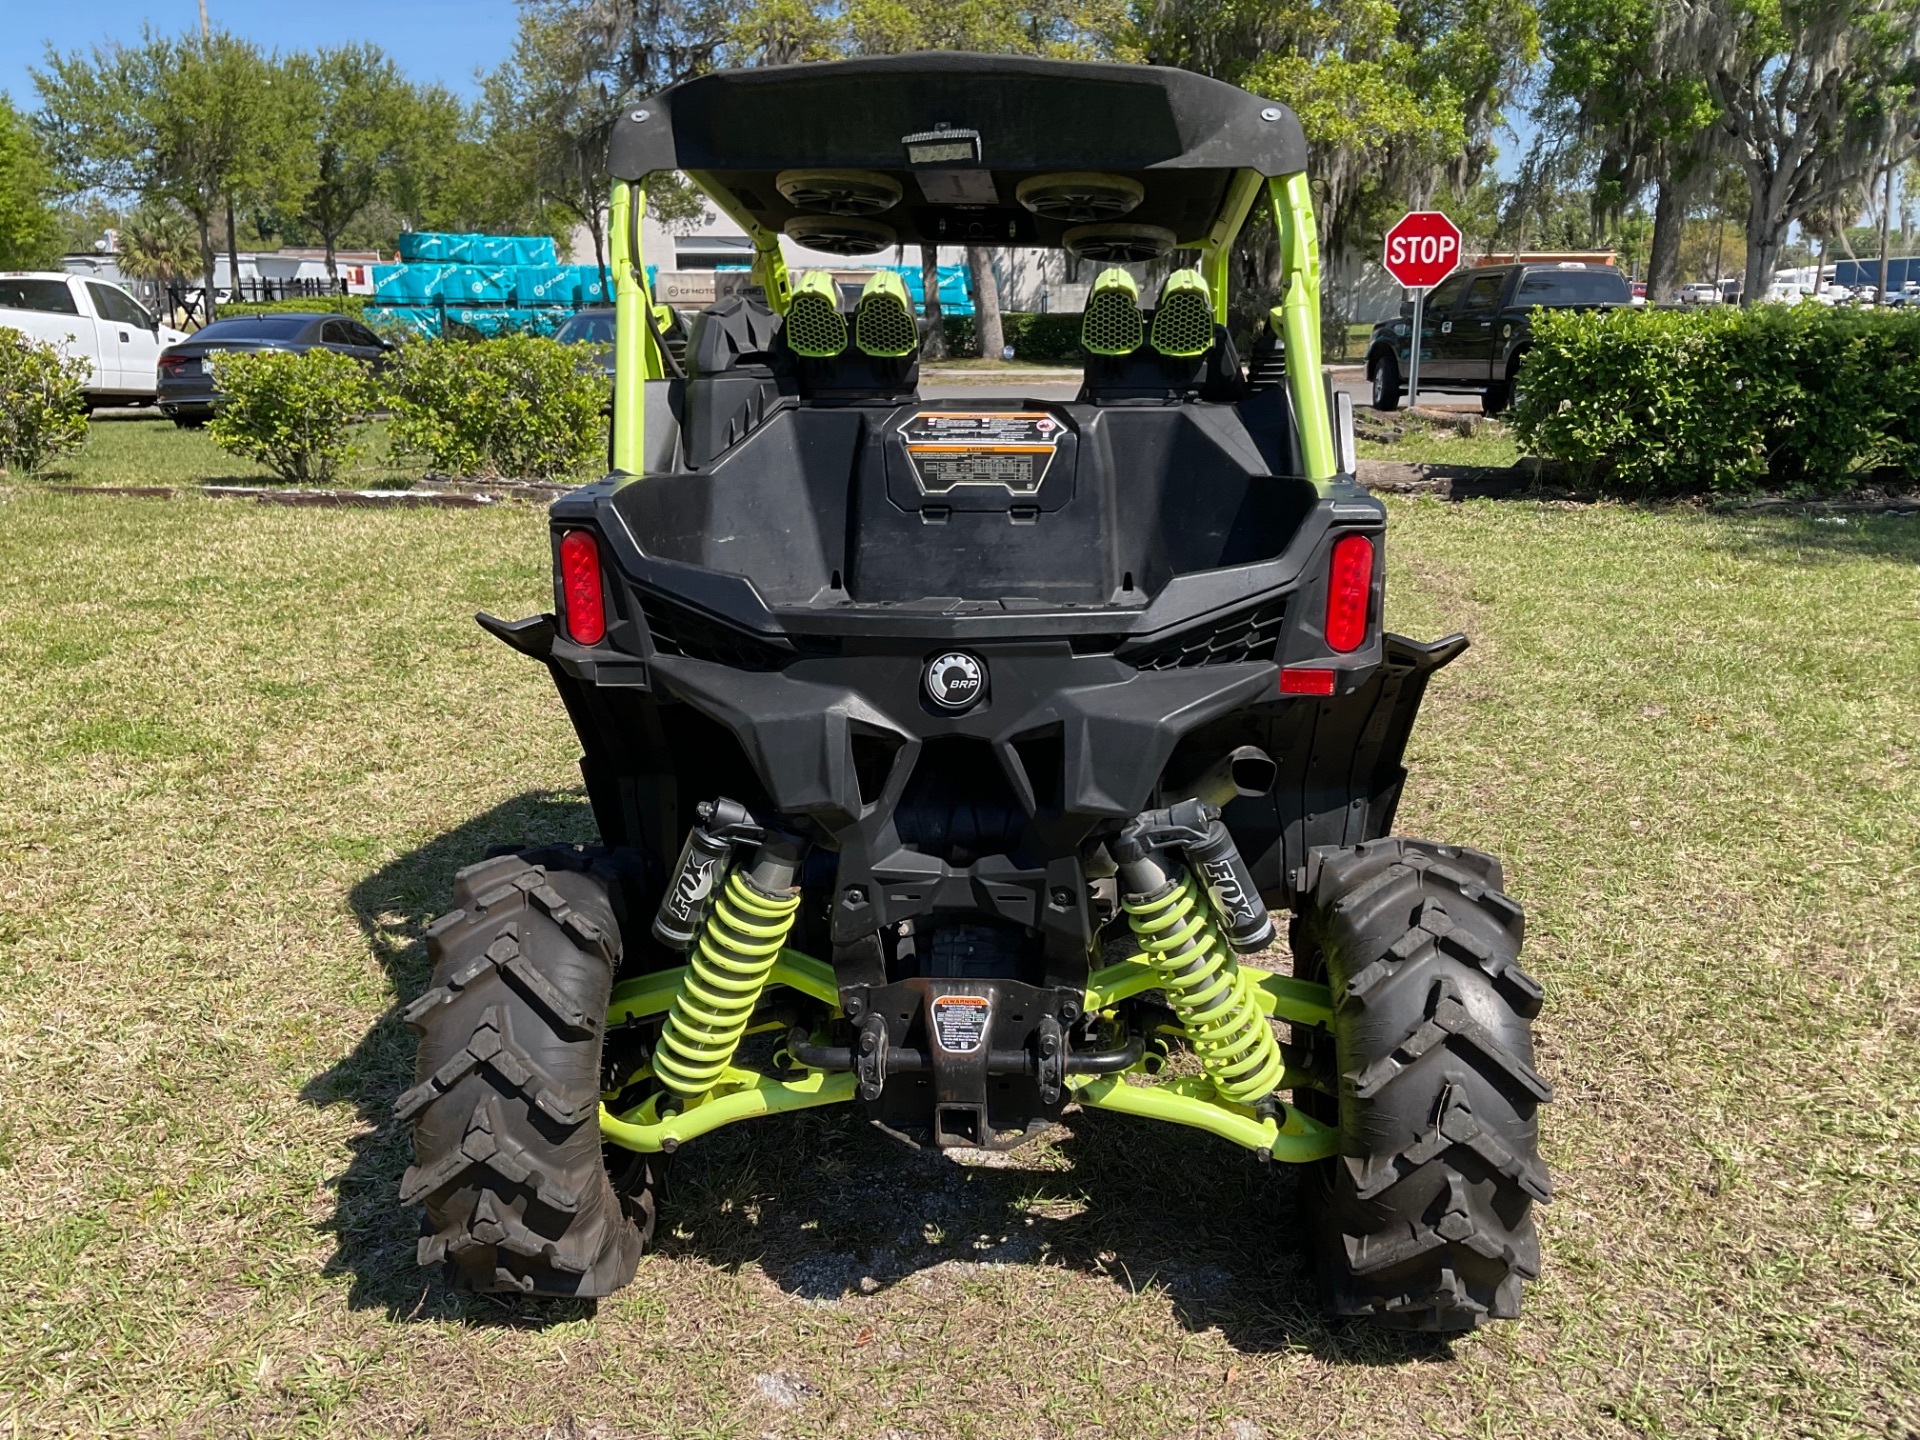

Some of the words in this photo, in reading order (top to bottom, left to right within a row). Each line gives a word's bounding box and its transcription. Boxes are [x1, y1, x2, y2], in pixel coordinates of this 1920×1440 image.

[1389, 235, 1455, 264] STOP
[950, 680, 978, 689] BRP
[668, 848, 716, 922] FOX
[1203, 859, 1256, 928] FOX
